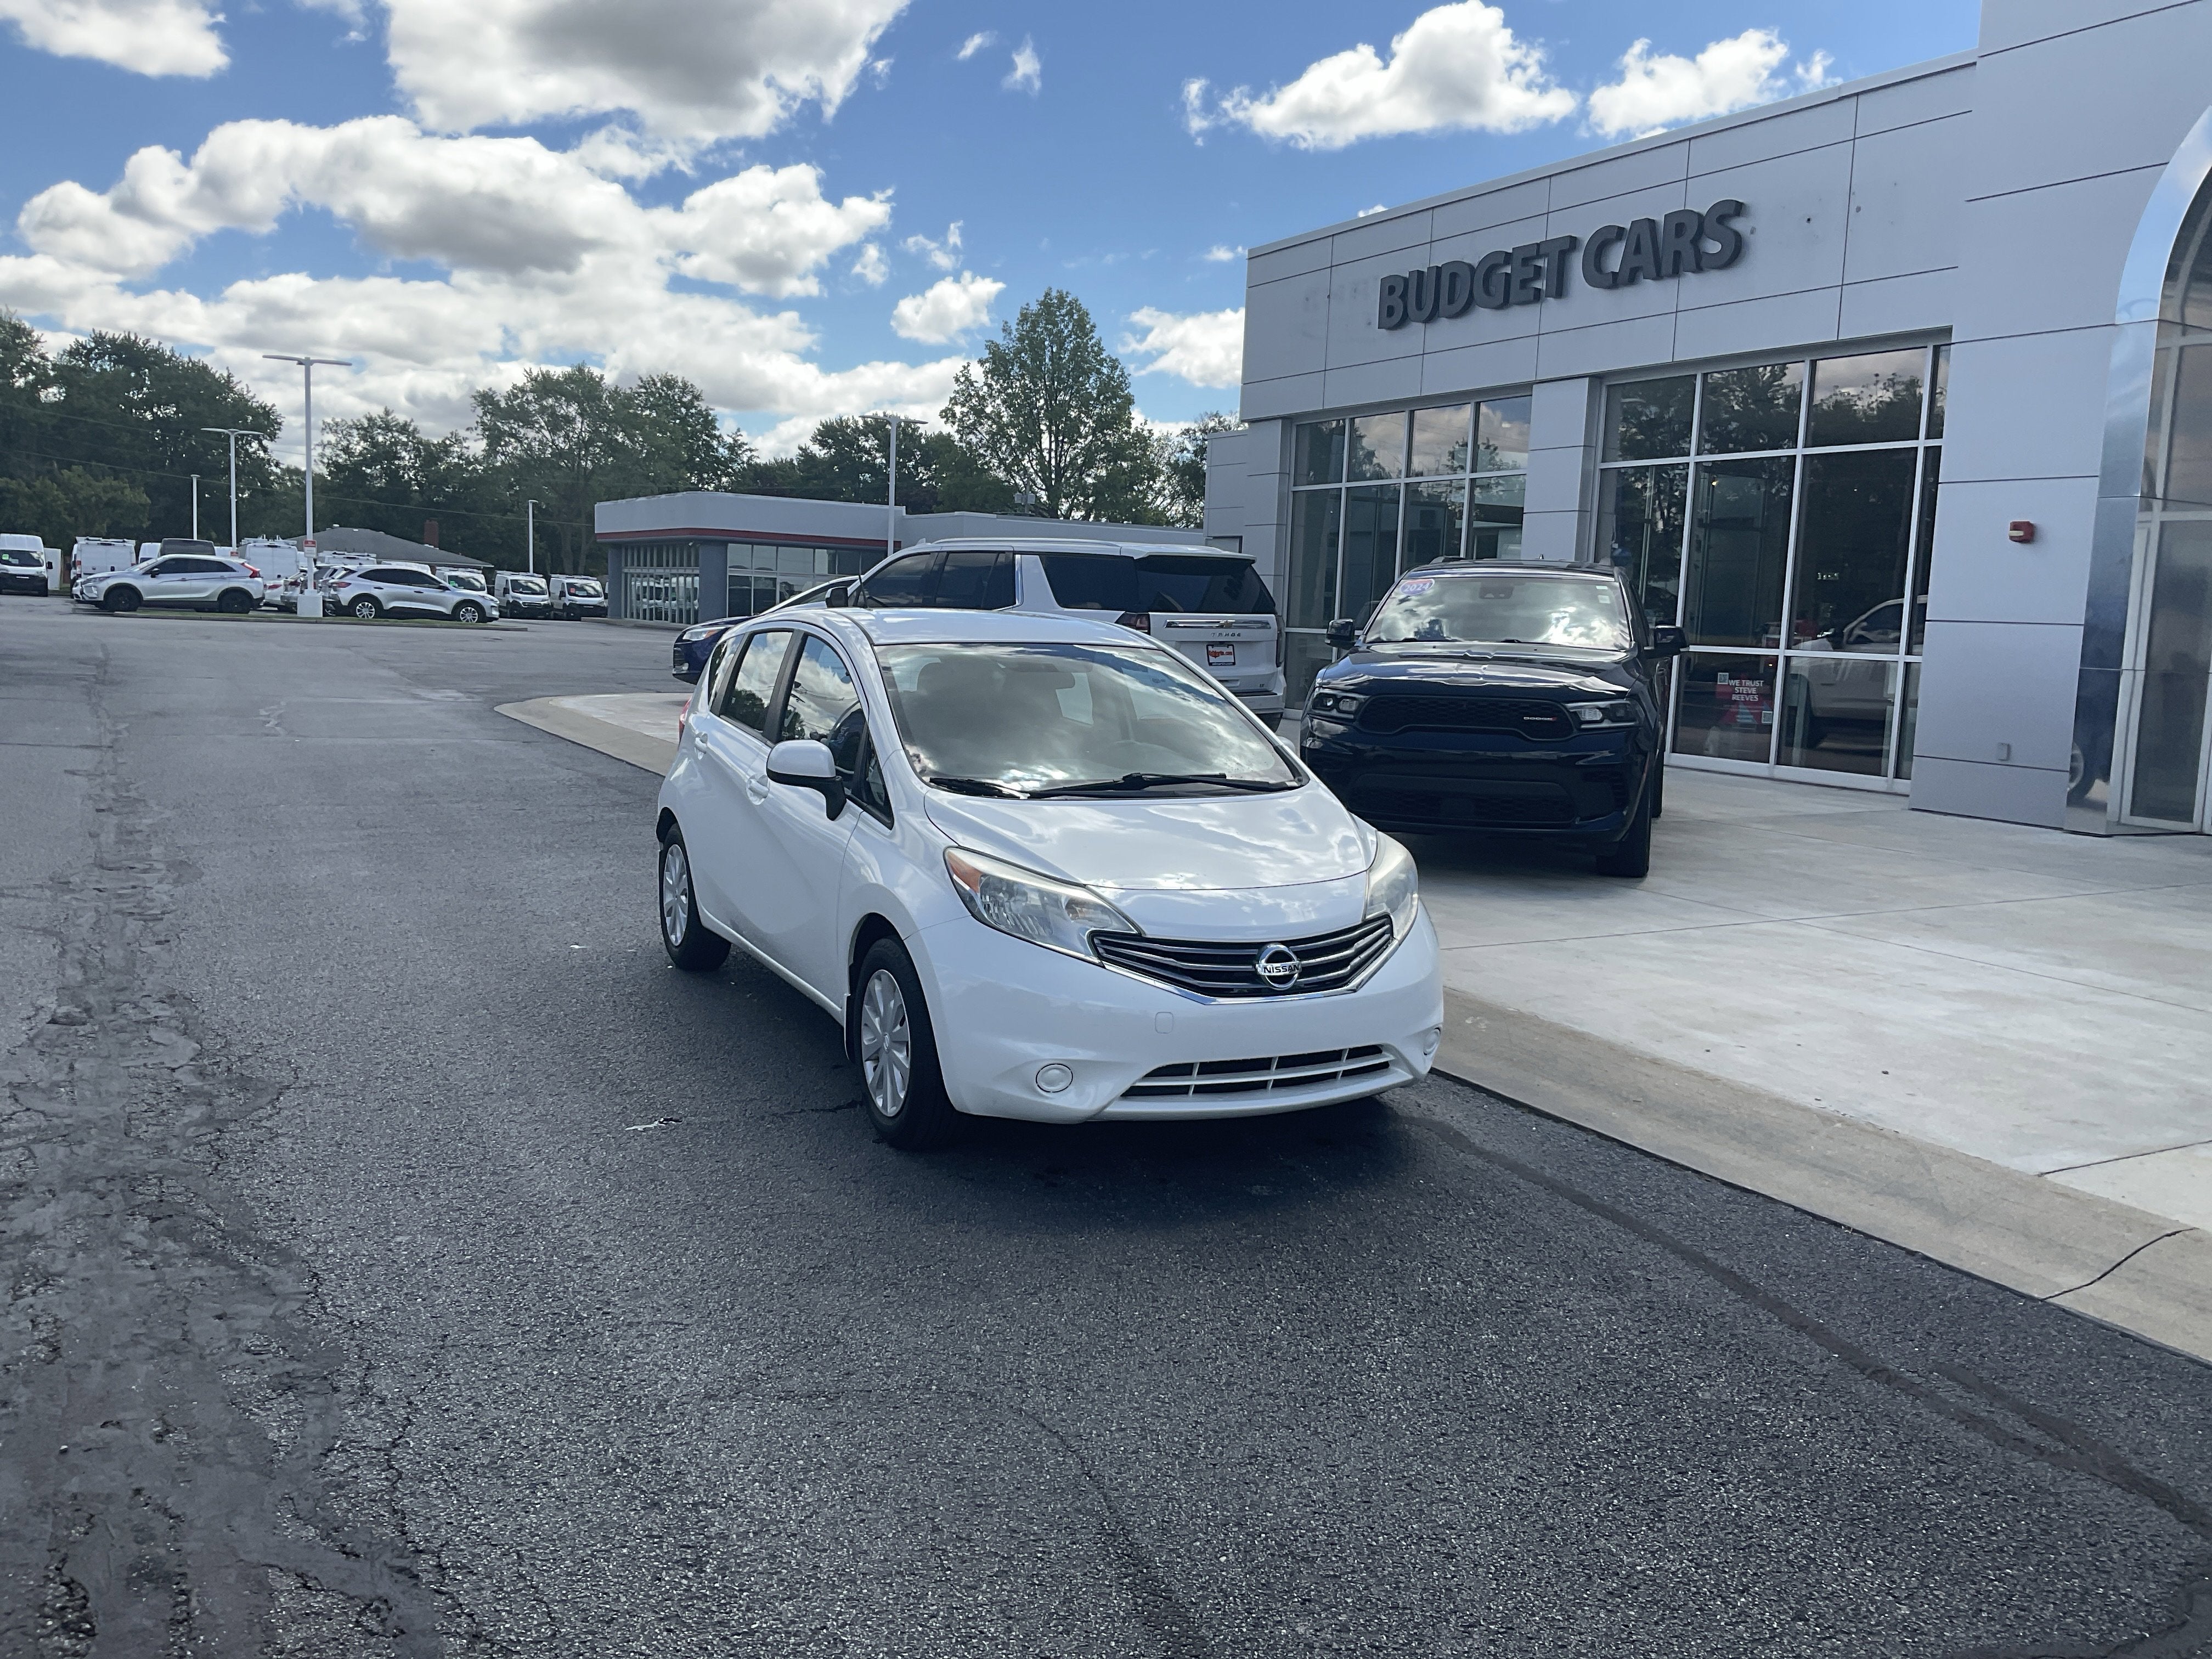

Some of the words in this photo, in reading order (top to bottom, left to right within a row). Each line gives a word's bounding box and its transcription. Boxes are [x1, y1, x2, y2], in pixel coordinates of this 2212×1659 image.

[1378, 235, 1578, 330] BUDGET
[1582, 199, 1745, 289] CARS
[1403, 583, 1430, 592] 2024
[1263, 964, 1300, 973] NISSAN
